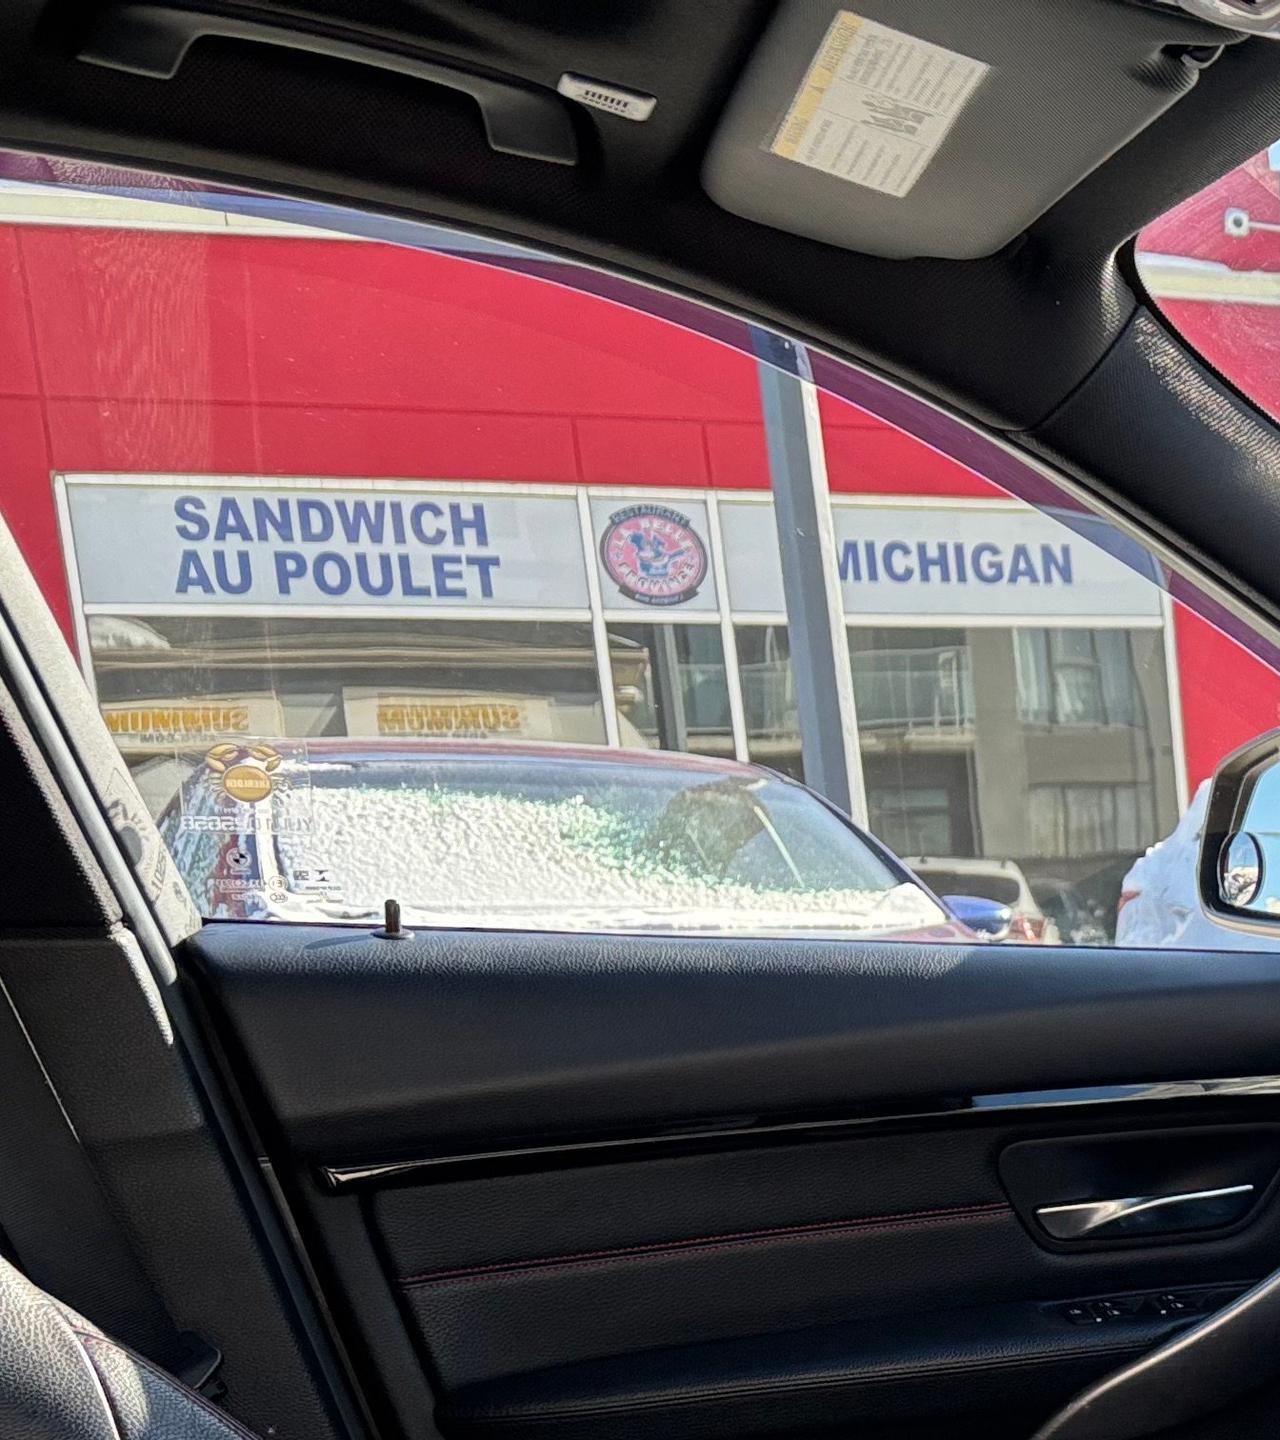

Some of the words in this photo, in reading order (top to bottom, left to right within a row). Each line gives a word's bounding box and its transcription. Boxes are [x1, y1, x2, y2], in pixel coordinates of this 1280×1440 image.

[174, 495, 489, 546] SANDWICH
[175, 549, 252, 595] AU
[274, 551, 500, 598] POULET
